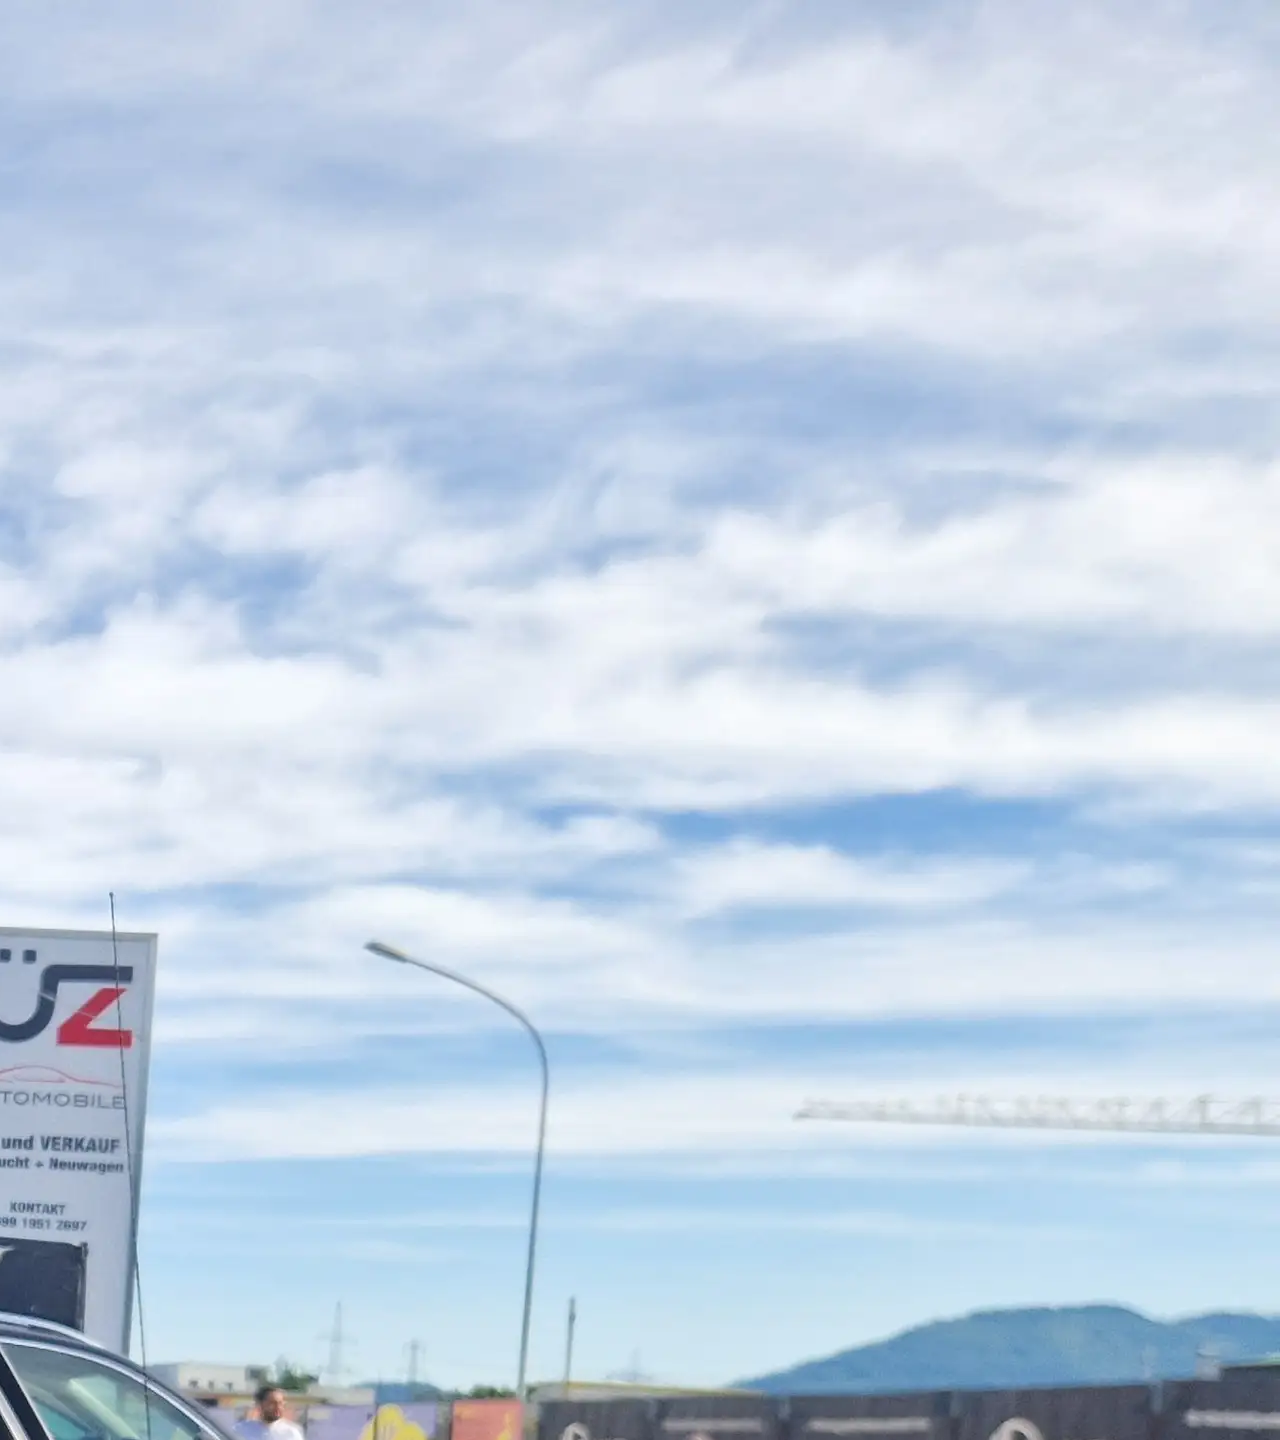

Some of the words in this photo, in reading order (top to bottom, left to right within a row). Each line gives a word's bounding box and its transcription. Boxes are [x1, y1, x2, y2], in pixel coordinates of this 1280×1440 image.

[1, 1135, 34, 1150] und
[41, 1136, 120, 1154] VERKAUF
[48, 1157, 124, 1175] Neuwagen
[9, 1201, 66, 1216] KONTAKT
